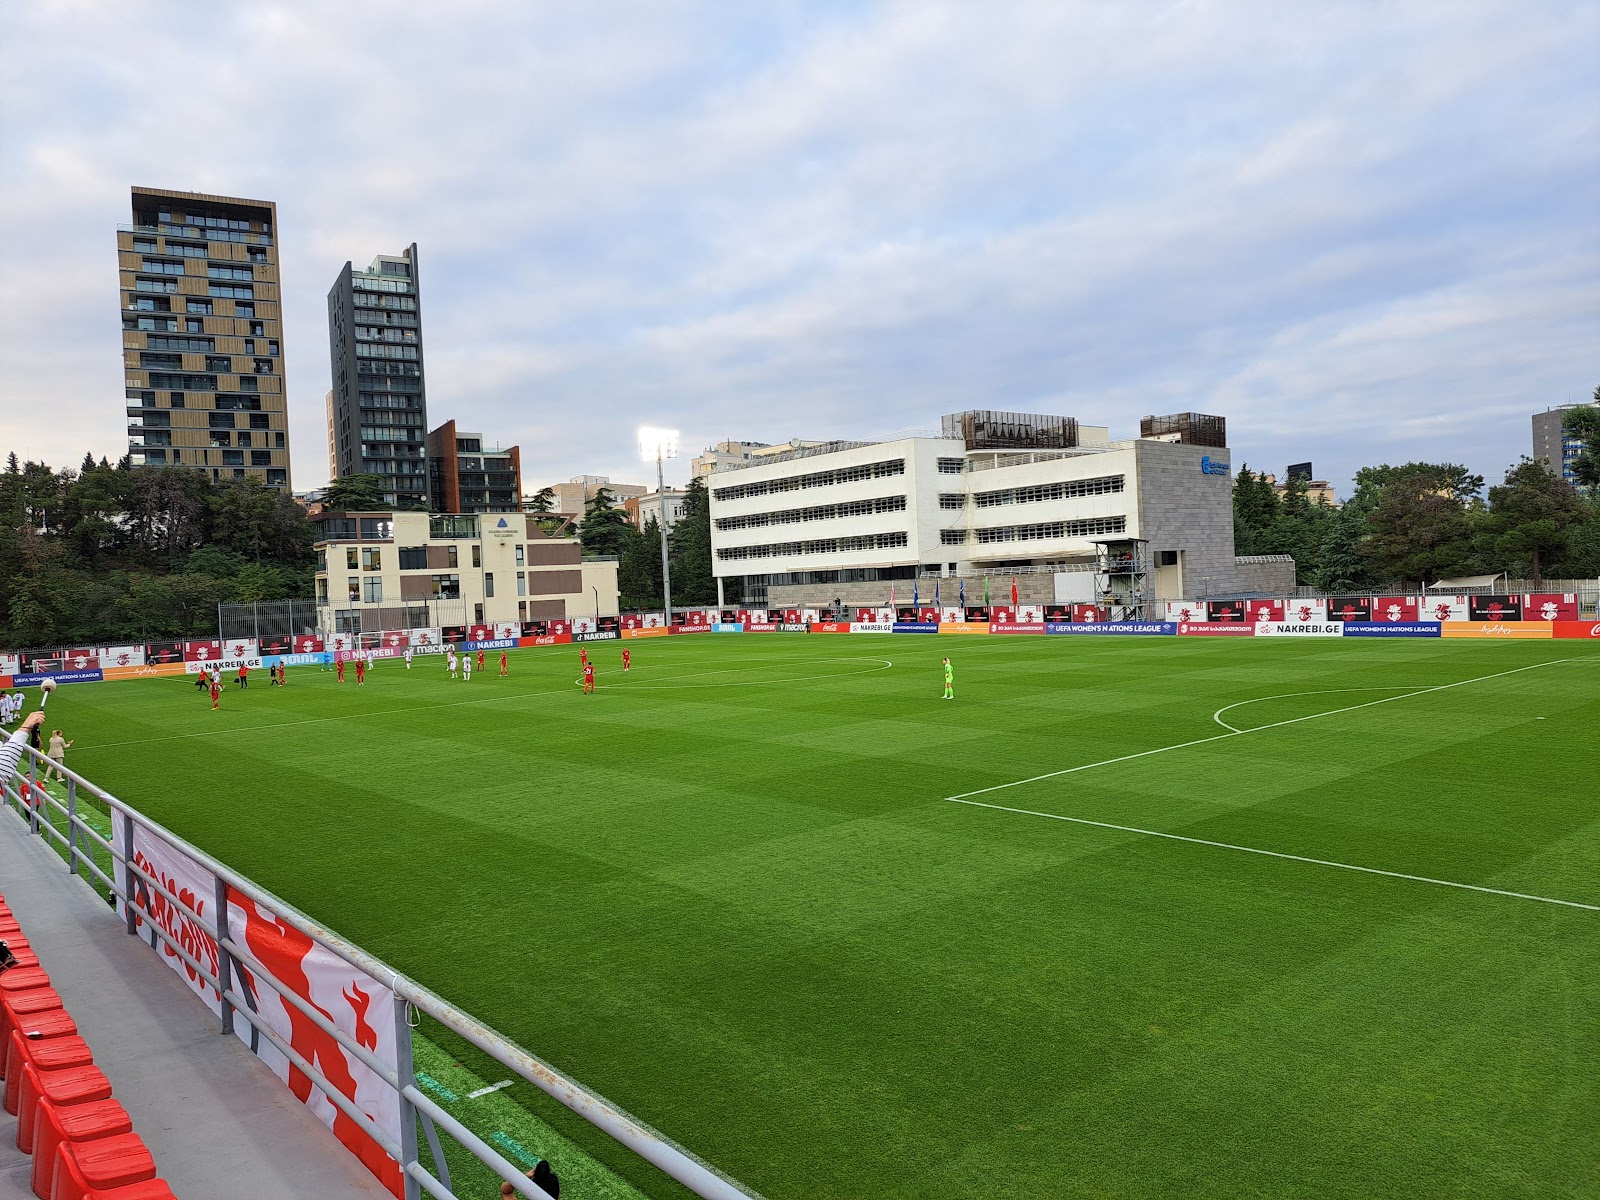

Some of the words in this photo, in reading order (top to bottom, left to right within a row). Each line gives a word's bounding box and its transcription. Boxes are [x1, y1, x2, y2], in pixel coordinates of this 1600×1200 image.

[1276, 625, 1340, 633] NAKREBI.GE
[584, 631, 616, 641] NAKREBI
[477, 639, 513, 649] NAKREBI
[205, 659, 260, 670] NAKREBI.GE
